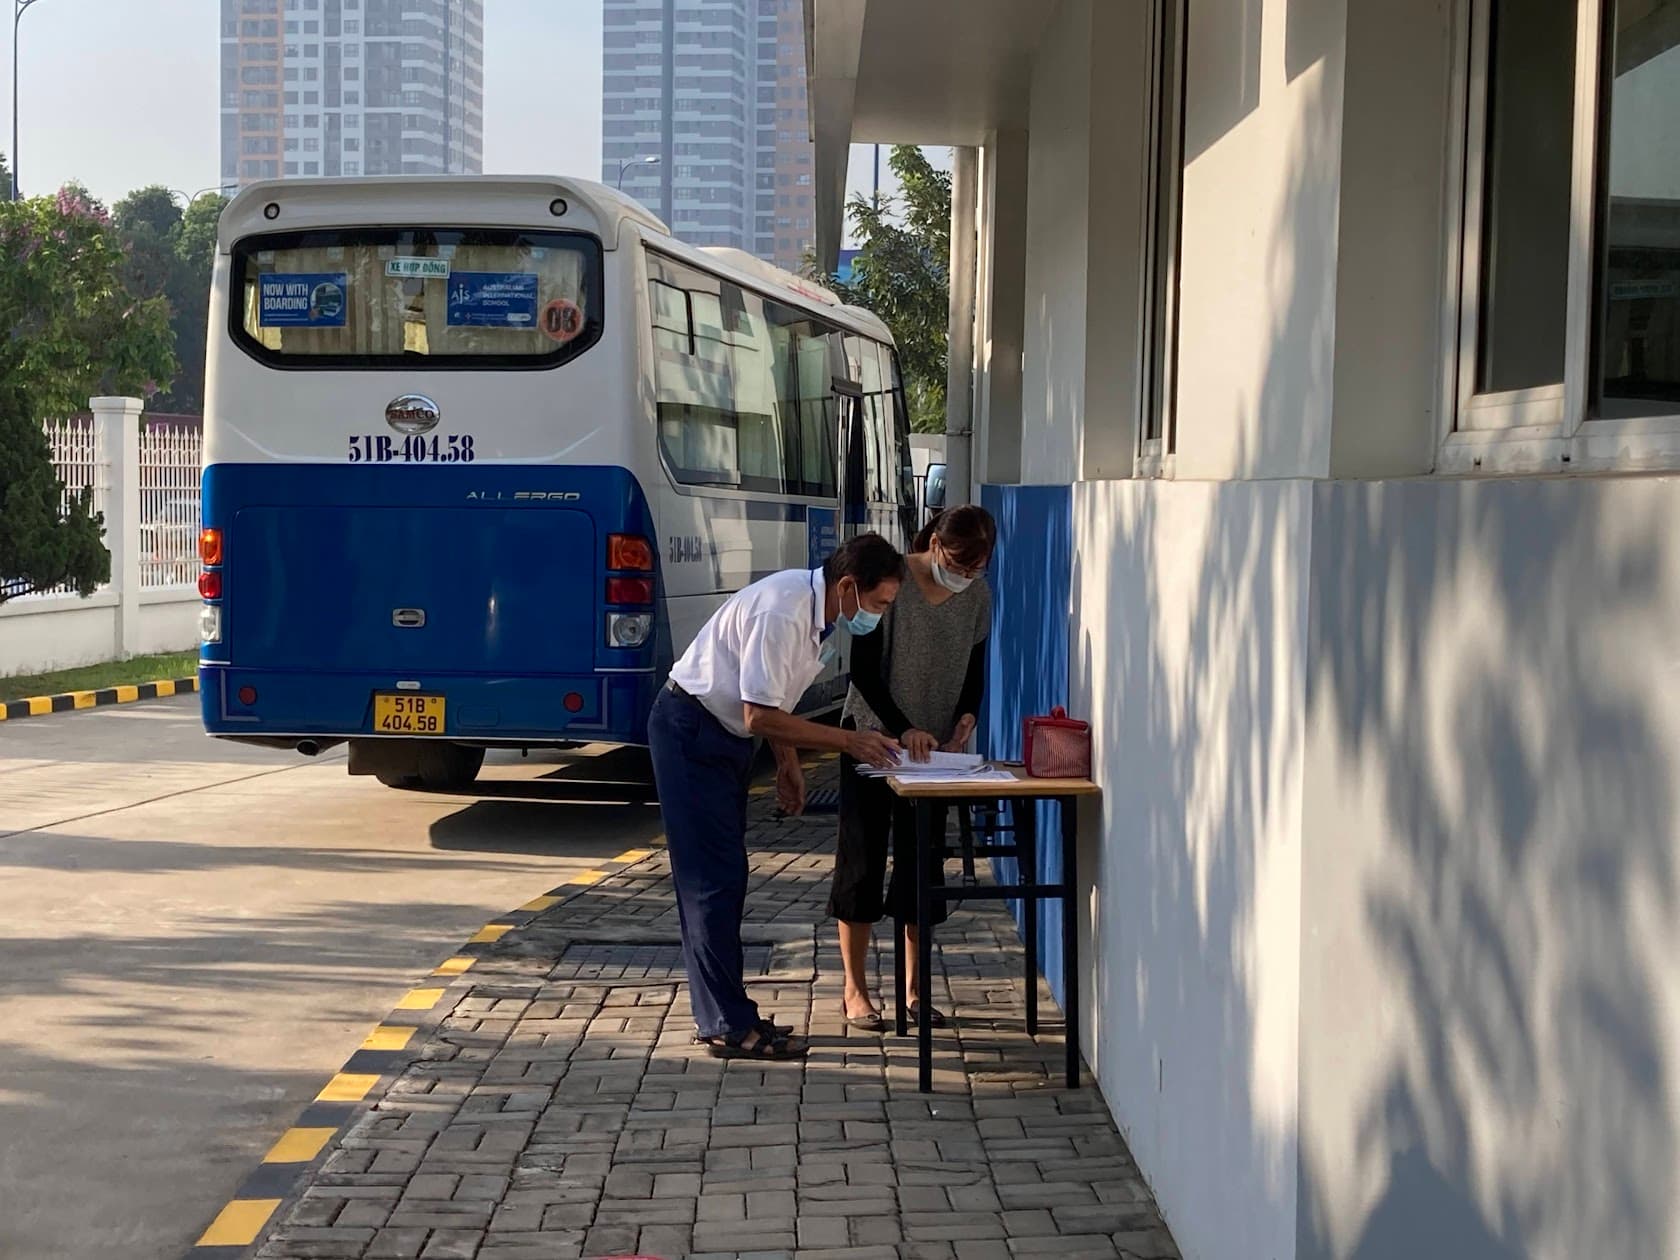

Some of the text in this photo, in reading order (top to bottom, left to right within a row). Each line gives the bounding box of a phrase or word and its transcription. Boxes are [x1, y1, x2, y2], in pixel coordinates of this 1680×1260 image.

[390, 262, 401, 272] XE
[263, 283, 308, 296] NOW WITH
[264, 298, 308, 310] BOARDING
[349, 434, 475, 463] 51B-404.58
[395, 697, 425, 713] 51B
[382, 714, 437, 731] 404.58
